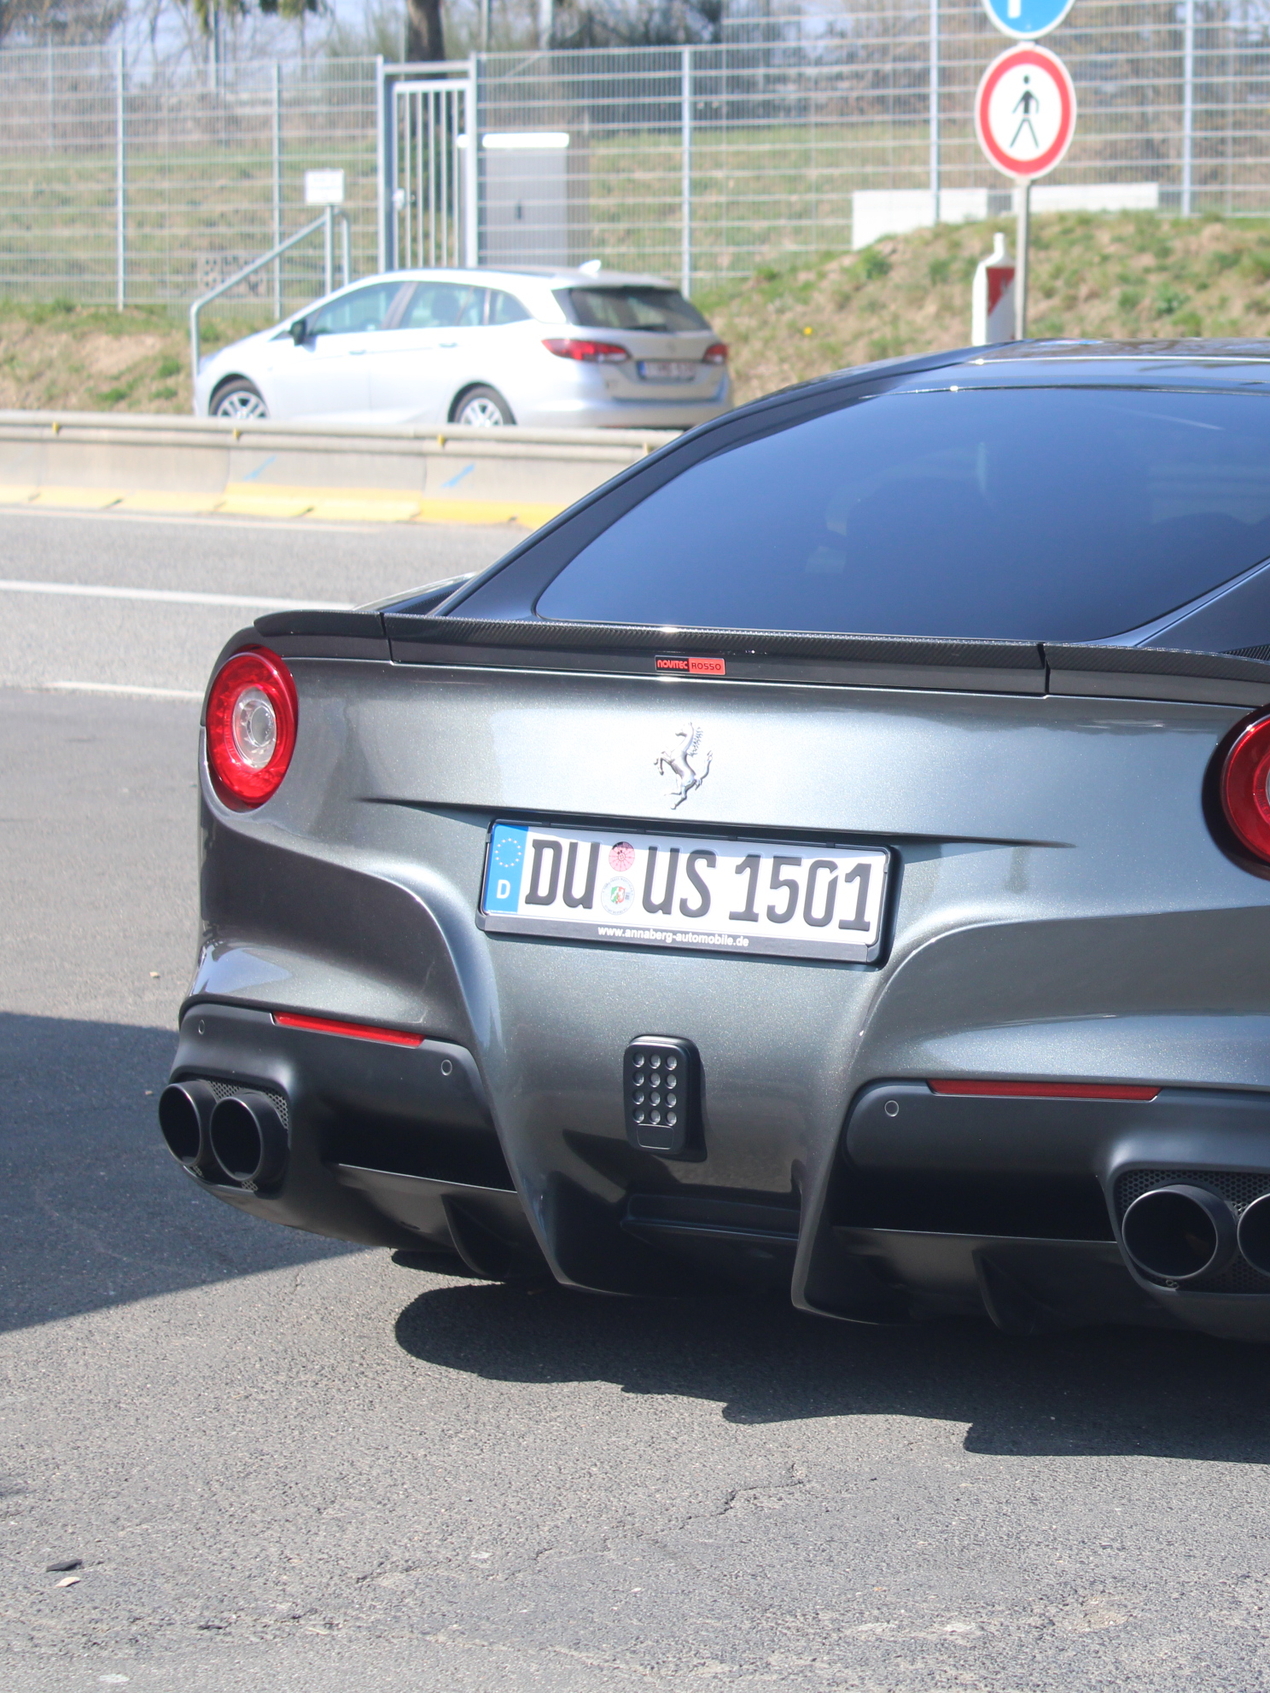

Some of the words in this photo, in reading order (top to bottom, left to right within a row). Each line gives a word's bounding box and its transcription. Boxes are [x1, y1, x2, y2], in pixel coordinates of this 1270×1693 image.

[691, 662, 722, 671] ROSSO
[495, 878, 511, 899] D
[525, 838, 598, 910] DU
[642, 845, 719, 918] US
[729, 854, 873, 932] 1501
[598, 926, 749, 947] www.annaberg-automobile.de
